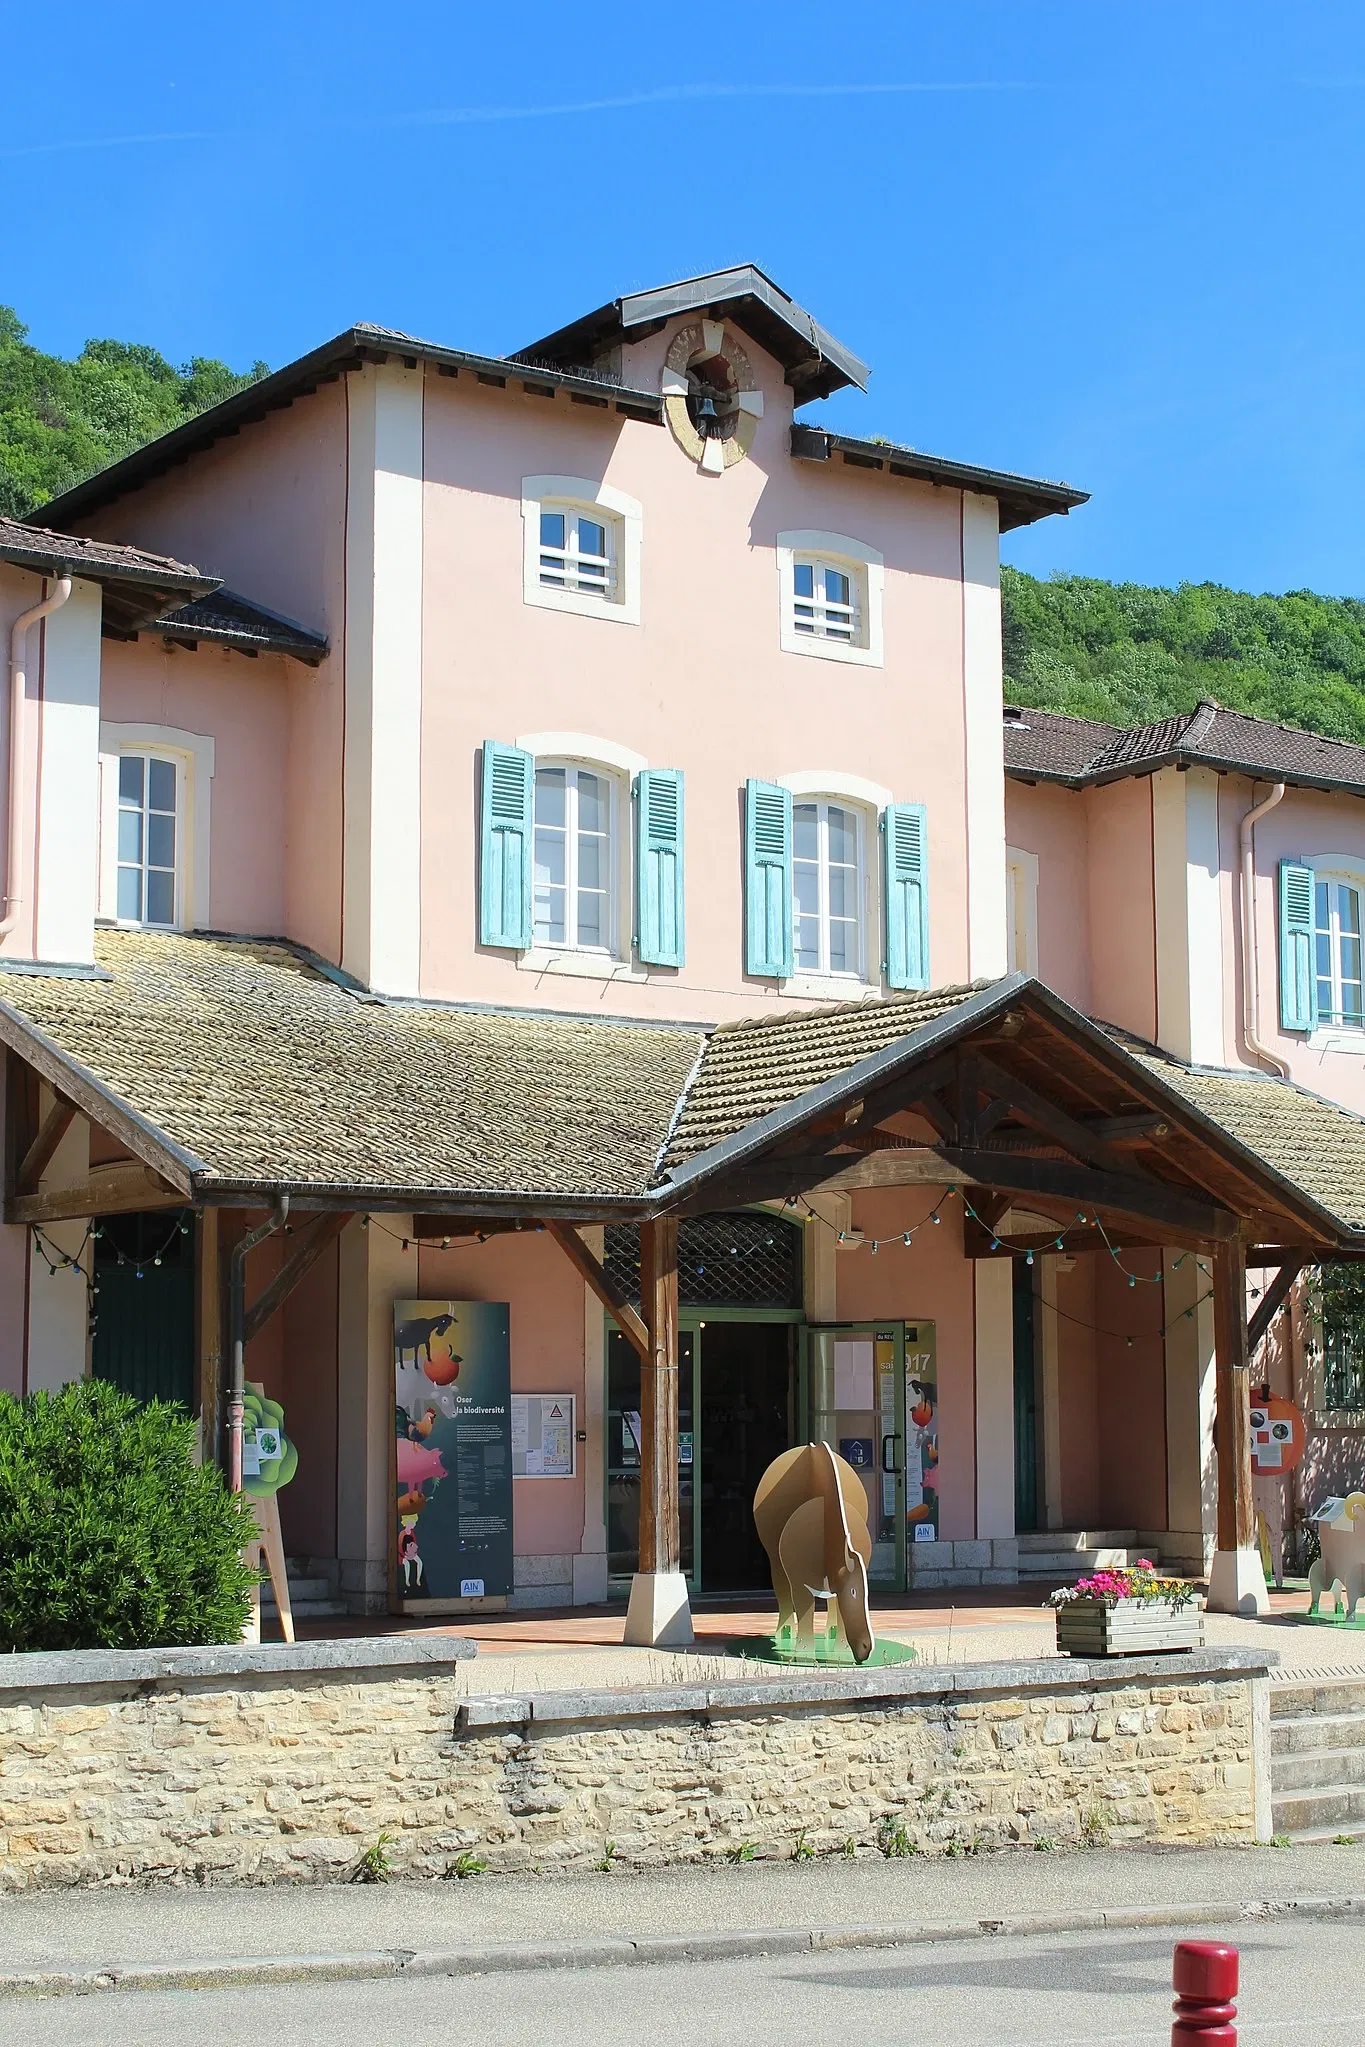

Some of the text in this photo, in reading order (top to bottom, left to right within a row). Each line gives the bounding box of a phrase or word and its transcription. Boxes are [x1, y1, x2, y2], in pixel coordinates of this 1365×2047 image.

[456, 1406, 505, 1414] la biodiversité
[916, 1527, 931, 1537] AIN
[463, 1582, 479, 1591] AIN
